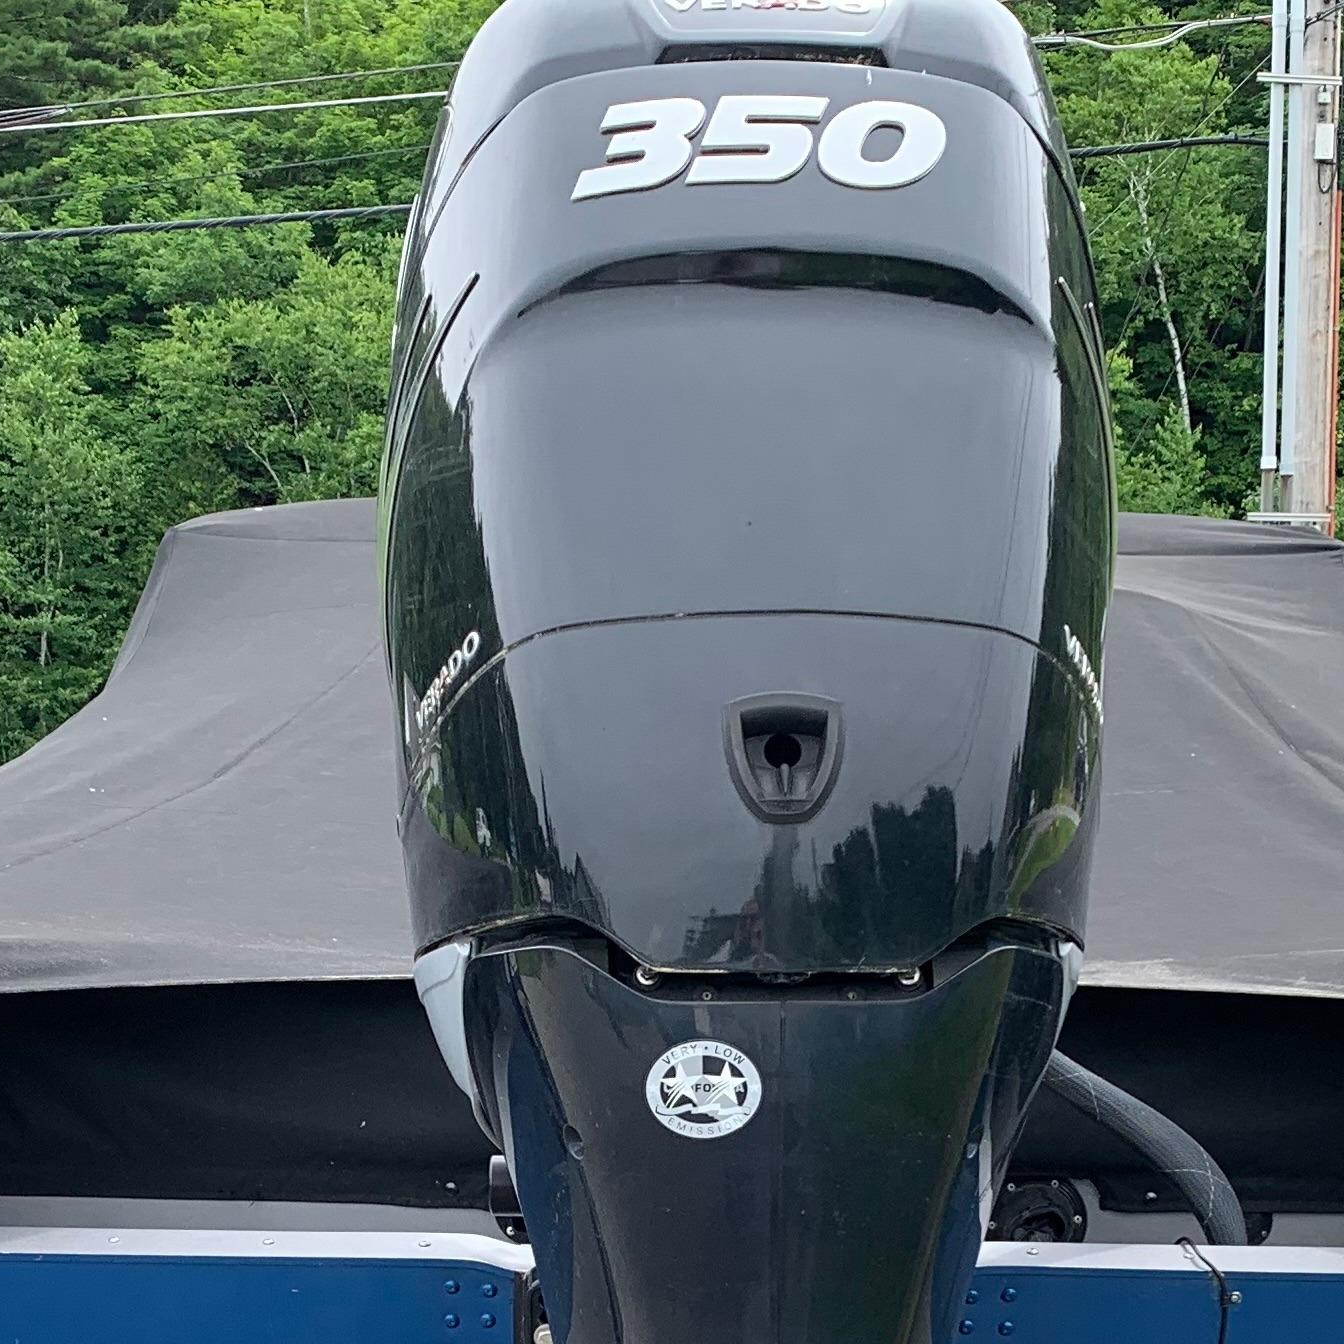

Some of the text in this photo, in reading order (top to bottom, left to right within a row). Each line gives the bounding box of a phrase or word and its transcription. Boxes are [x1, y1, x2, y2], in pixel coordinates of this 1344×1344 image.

[570, 95, 948, 203] 350
[662, 1043, 746, 1066] VERY LOW
